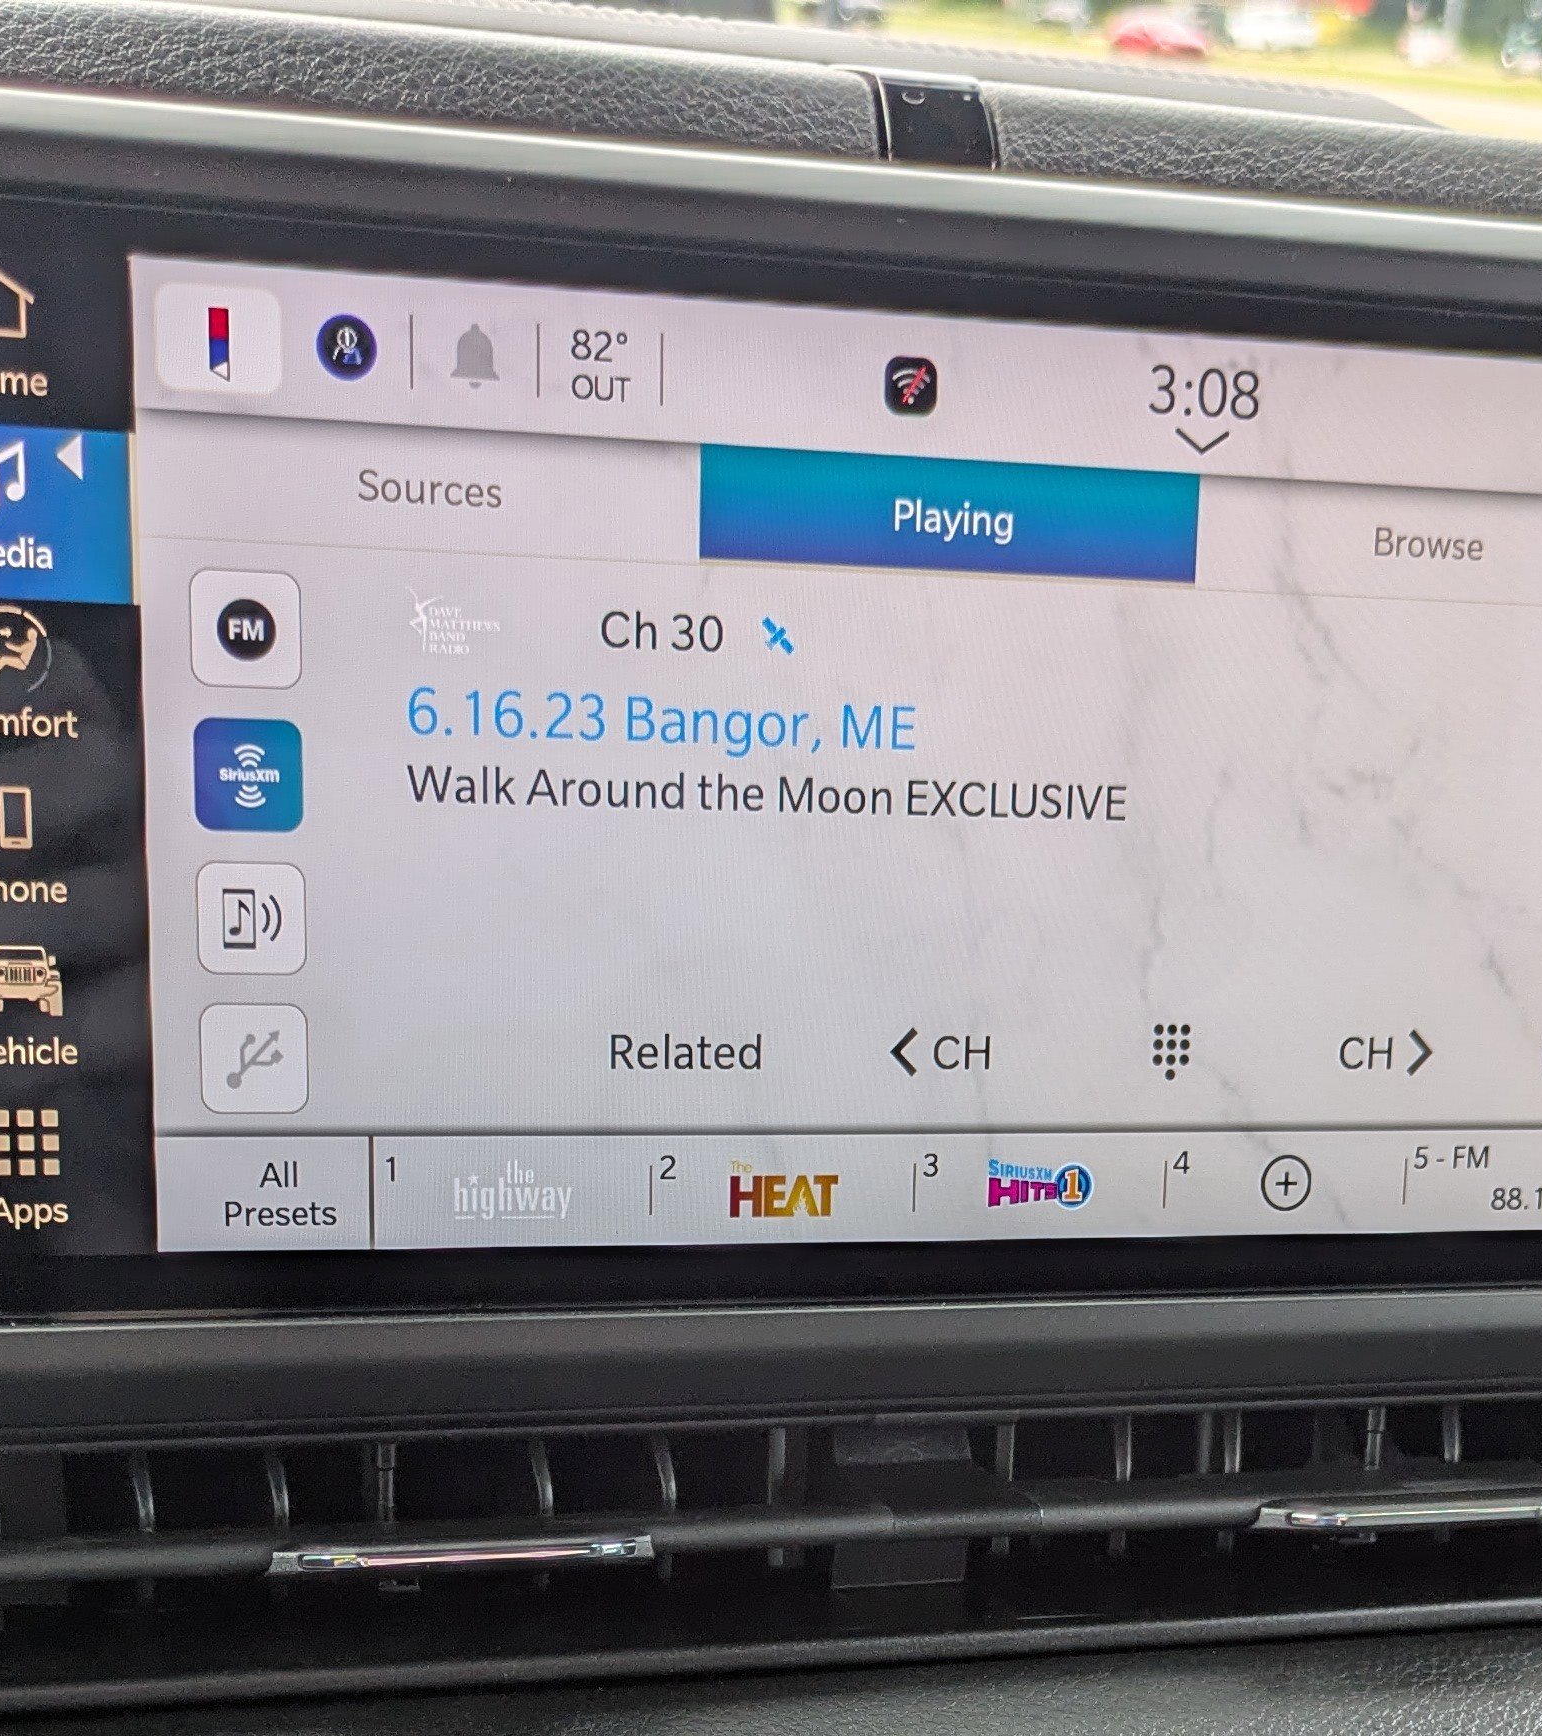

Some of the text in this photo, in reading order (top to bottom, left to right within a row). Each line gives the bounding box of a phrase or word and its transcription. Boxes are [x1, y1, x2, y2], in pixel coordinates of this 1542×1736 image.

[572, 374, 632, 404] OUT
[1148, 365, 1260, 421] 3:08
[358, 470, 503, 511] Sources
[893, 499, 1015, 546] Playing
[1373, 527, 1485, 563] Browse
[227, 617, 266, 645] FM
[601, 610, 725, 653] Ch 30
[407, 687, 917, 757] 6.16.23 Bangor, ME
[407, 764, 1128, 822] Walk Around the Moon EXCLUSIVE
[609, 1034, 763, 1072] Related
[932, 1035, 992, 1071] CH
[1339, 1037, 1393, 1071] CH
[385, 1156, 397, 1182] 1
[506, 1159, 535, 1185] the
[660, 1155, 677, 1180] 2
[923, 1153, 940, 1177] 3
[1173, 1150, 1191, 1176] 4
[1414, 1146, 1429, 1169] 5
[1452, 1145, 1490, 1169] FM
[259, 1160, 299, 1189] All
[454, 1177, 572, 1220] highway
[729, 1174, 839, 1218] HEAT
[988, 1177, 1058, 1207] HITS
[224, 1200, 338, 1228] Presets
